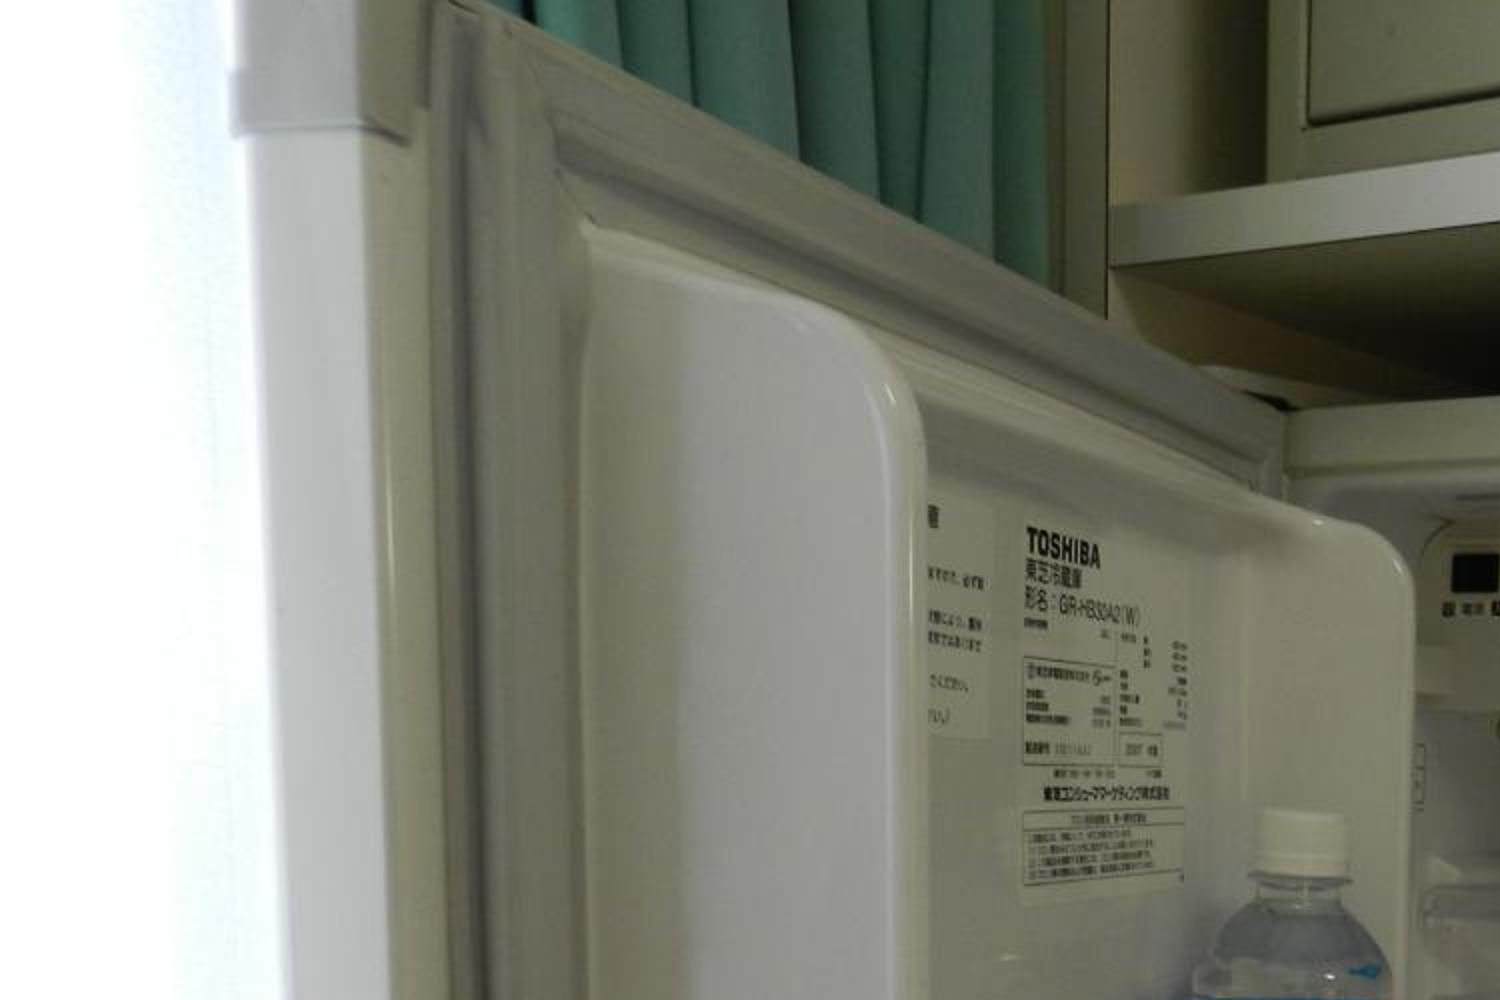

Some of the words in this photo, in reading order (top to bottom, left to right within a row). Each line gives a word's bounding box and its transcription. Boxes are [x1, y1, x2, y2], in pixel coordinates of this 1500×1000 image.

[1026, 526, 1101, 570] TOSHIBA
[1025, 558, 1082, 590] 東芝冷蔵庫
